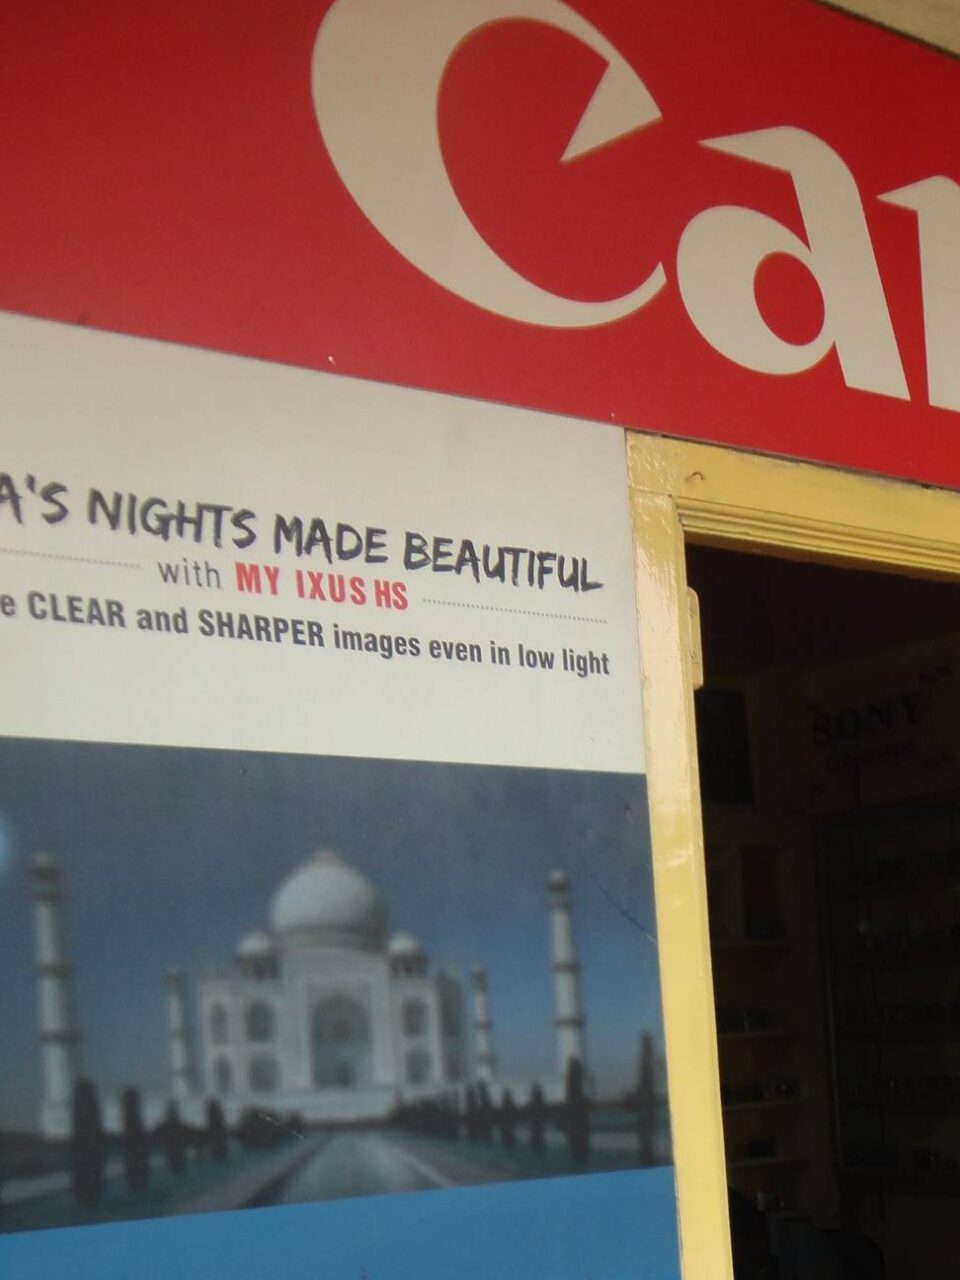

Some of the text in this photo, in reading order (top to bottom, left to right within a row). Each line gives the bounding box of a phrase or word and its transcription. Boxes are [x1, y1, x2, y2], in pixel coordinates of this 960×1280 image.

[87, 486, 257, 550] NIGHTS
[273, 513, 389, 565] MADE
[403, 529, 605, 593] BEAUTIFUL
[157, 557, 409, 611] with MY IXUS HS
[27, 590, 126, 629] CLEAR
[136, 602, 189, 635] and
[198, 610, 325, 650] SHARPER
[333, 622, 421, 661] images
[429, 638, 483, 666] even
[490, 640, 511, 667] in
[518, 641, 555, 672] low
[562, 646, 611, 679] light
